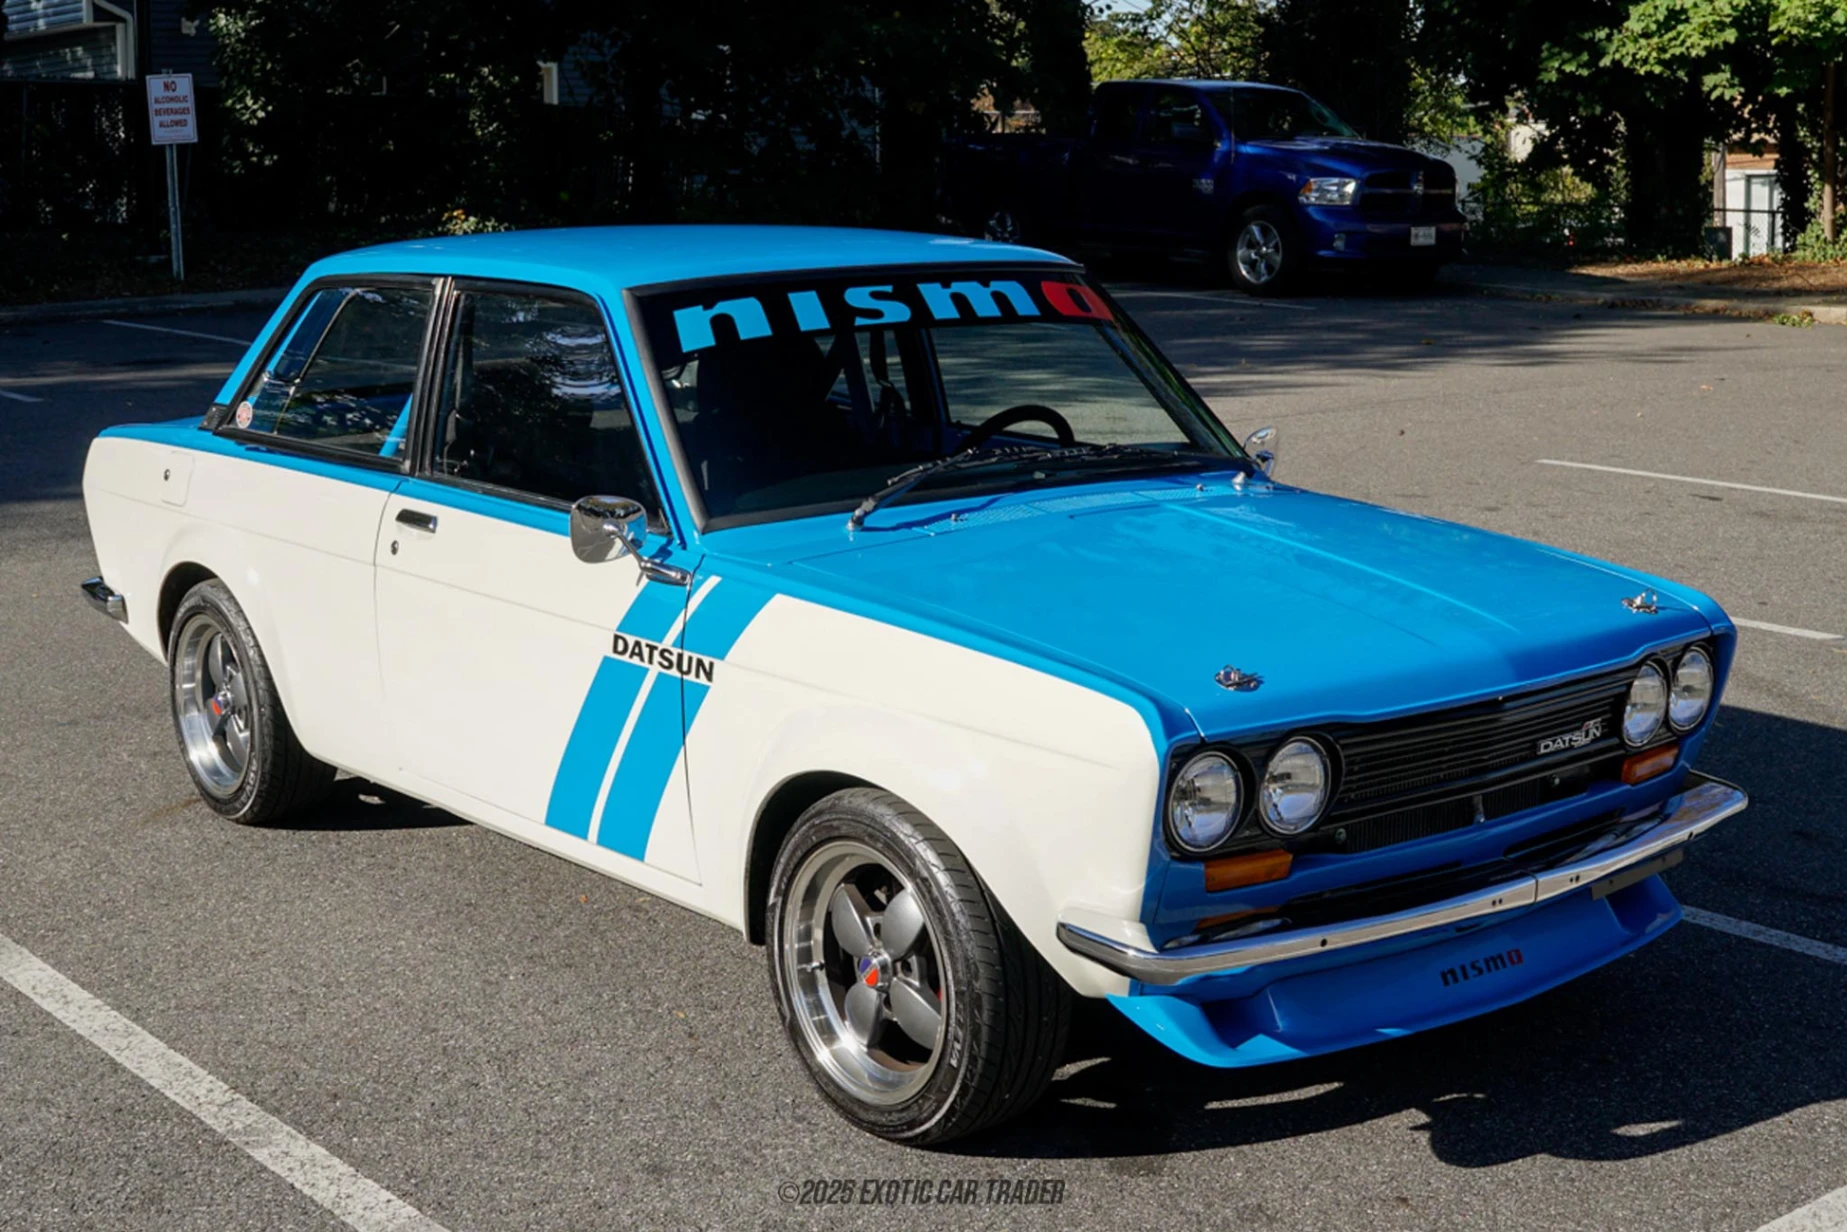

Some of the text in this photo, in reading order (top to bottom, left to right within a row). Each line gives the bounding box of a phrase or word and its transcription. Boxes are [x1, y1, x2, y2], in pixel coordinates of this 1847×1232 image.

[163, 80, 177, 92] NO
[154, 95, 188, 104] ALCOHOLIC
[154, 106, 191, 116] BEVERAGES
[159, 118, 188, 128] ALLOWED
[673, 280, 1113, 353] nismo
[612, 633, 715, 683] DATSUN
[1537, 721, 1601, 755] DATSUN
[1440, 948, 1524, 987] nismo
